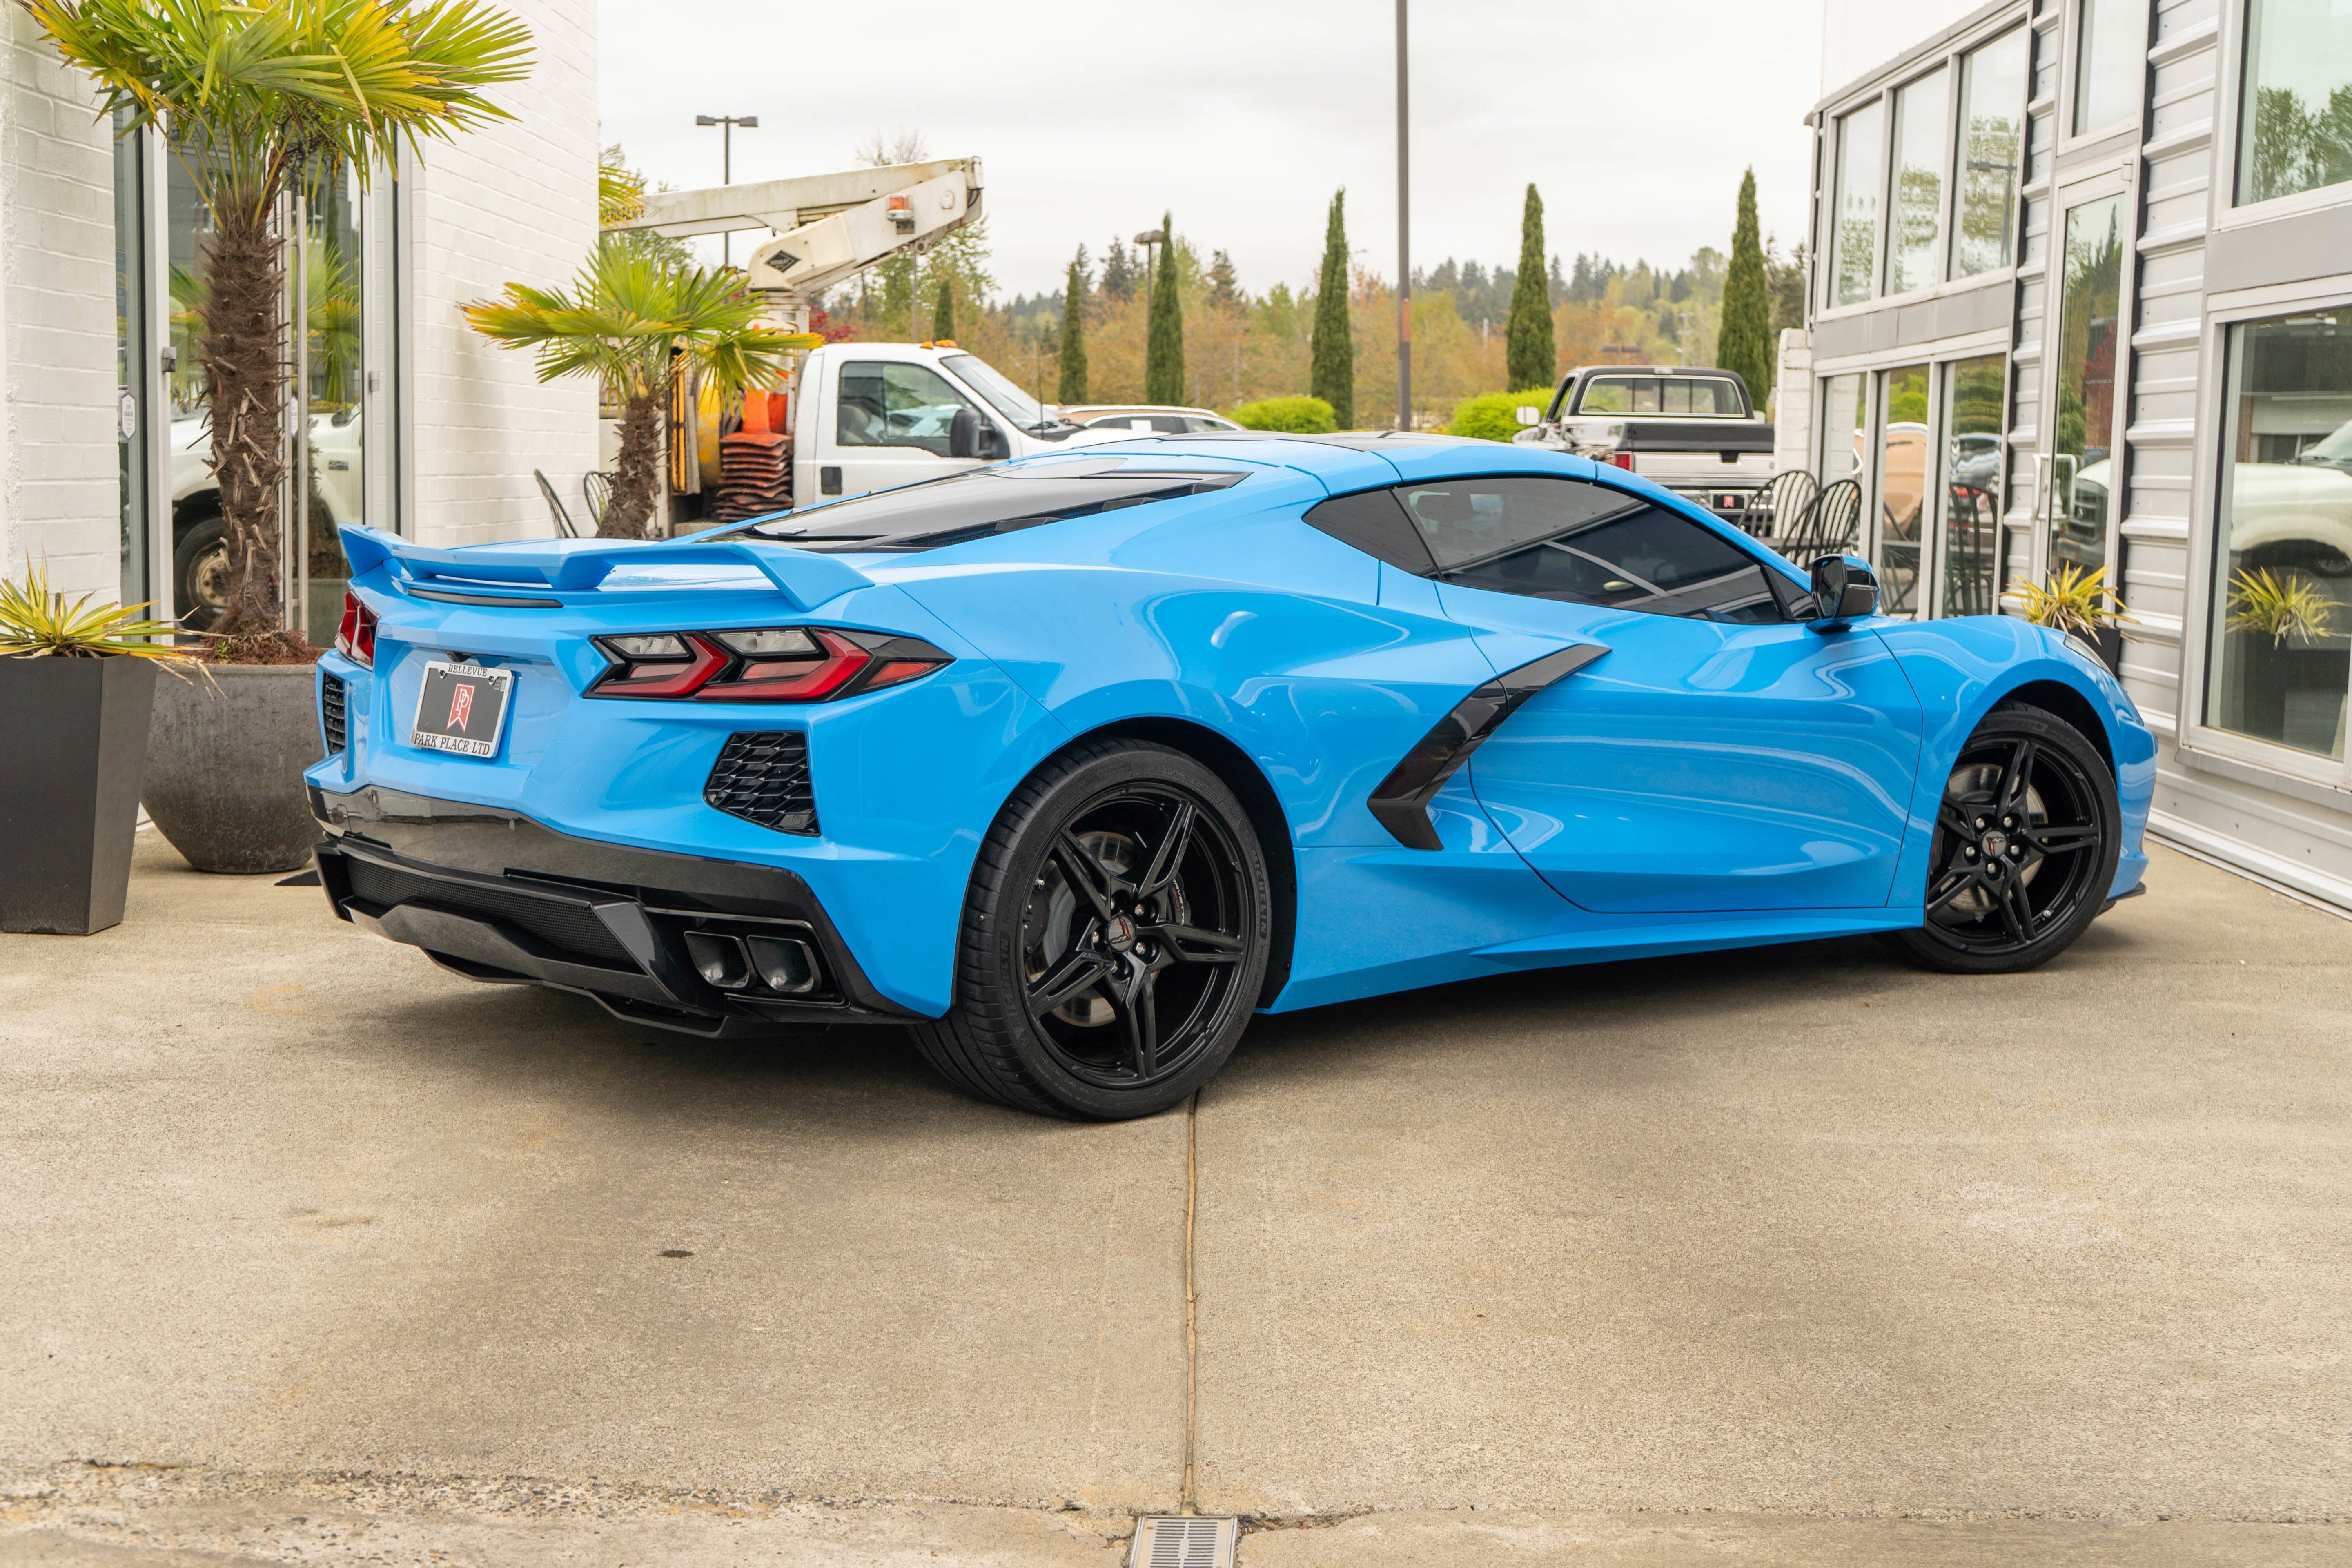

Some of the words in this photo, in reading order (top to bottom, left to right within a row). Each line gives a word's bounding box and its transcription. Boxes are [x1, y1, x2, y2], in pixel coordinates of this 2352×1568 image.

[448, 664, 488, 677] BELLEVUE
[414, 733, 438, 747] PARK
[440, 737, 469, 752] PLACE
[472, 742, 490, 755] LTD
[1250, 849, 1267, 933] MICHELIN
[1000, 937, 1022, 1029] MICHELIN
